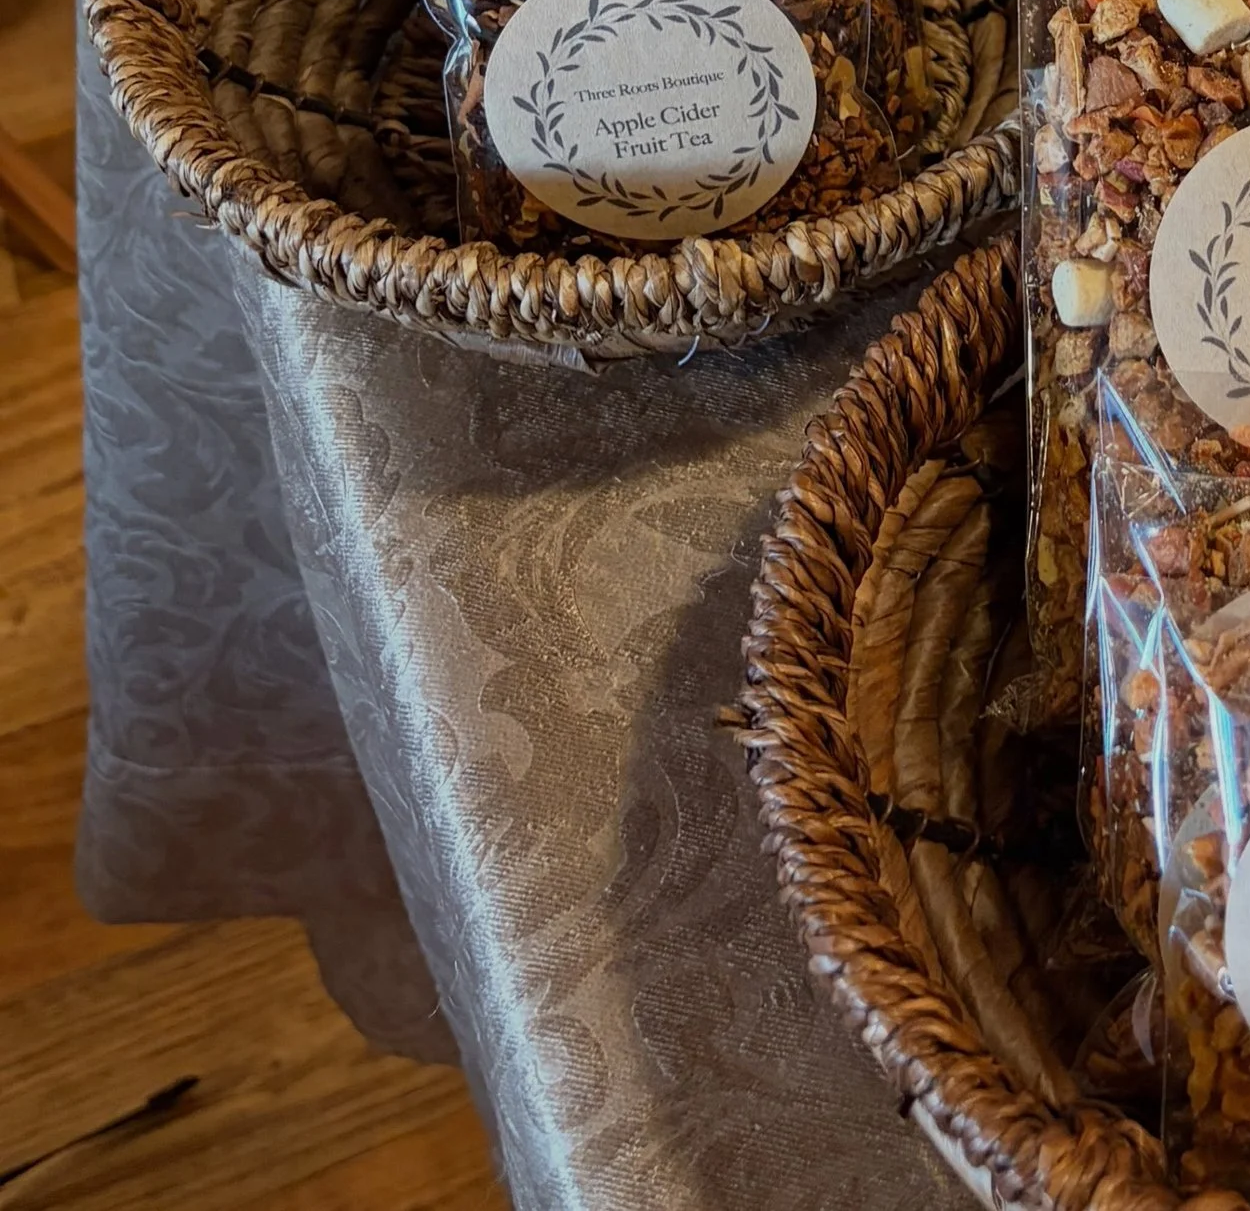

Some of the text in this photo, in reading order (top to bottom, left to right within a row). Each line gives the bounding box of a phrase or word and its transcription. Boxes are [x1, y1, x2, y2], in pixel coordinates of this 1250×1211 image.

[574, 70, 725, 104] Three Roots Boutique
[594, 102, 721, 139] Apple Cider
[613, 130, 714, 159] Fruit Tea
